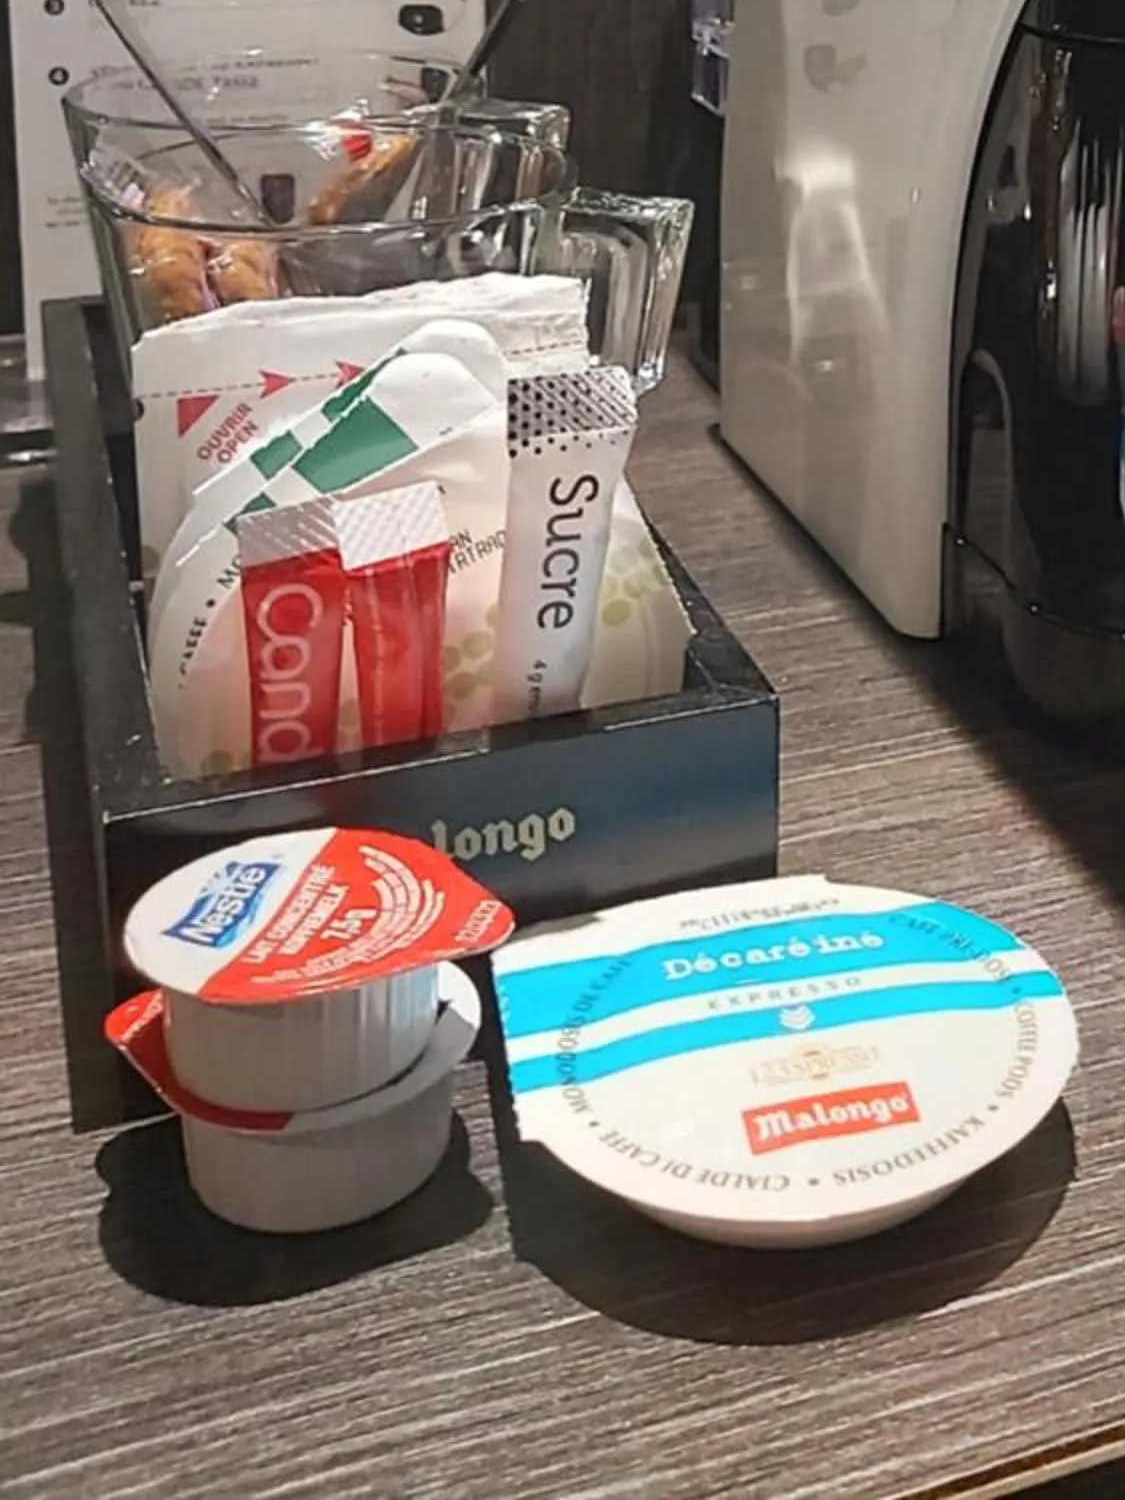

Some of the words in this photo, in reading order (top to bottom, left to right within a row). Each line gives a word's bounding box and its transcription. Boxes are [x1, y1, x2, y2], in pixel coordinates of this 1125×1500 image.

[196, 402, 253, 460] OUVRIR
[216, 420, 259, 464] OPEN
[536, 474, 600, 630] Sucre
[257, 583, 326, 762] Cand
[431, 806, 576, 862] longo
[707, 975, 862, 1010] EXPRESSO
[753, 1094, 909, 1141] Malongo
